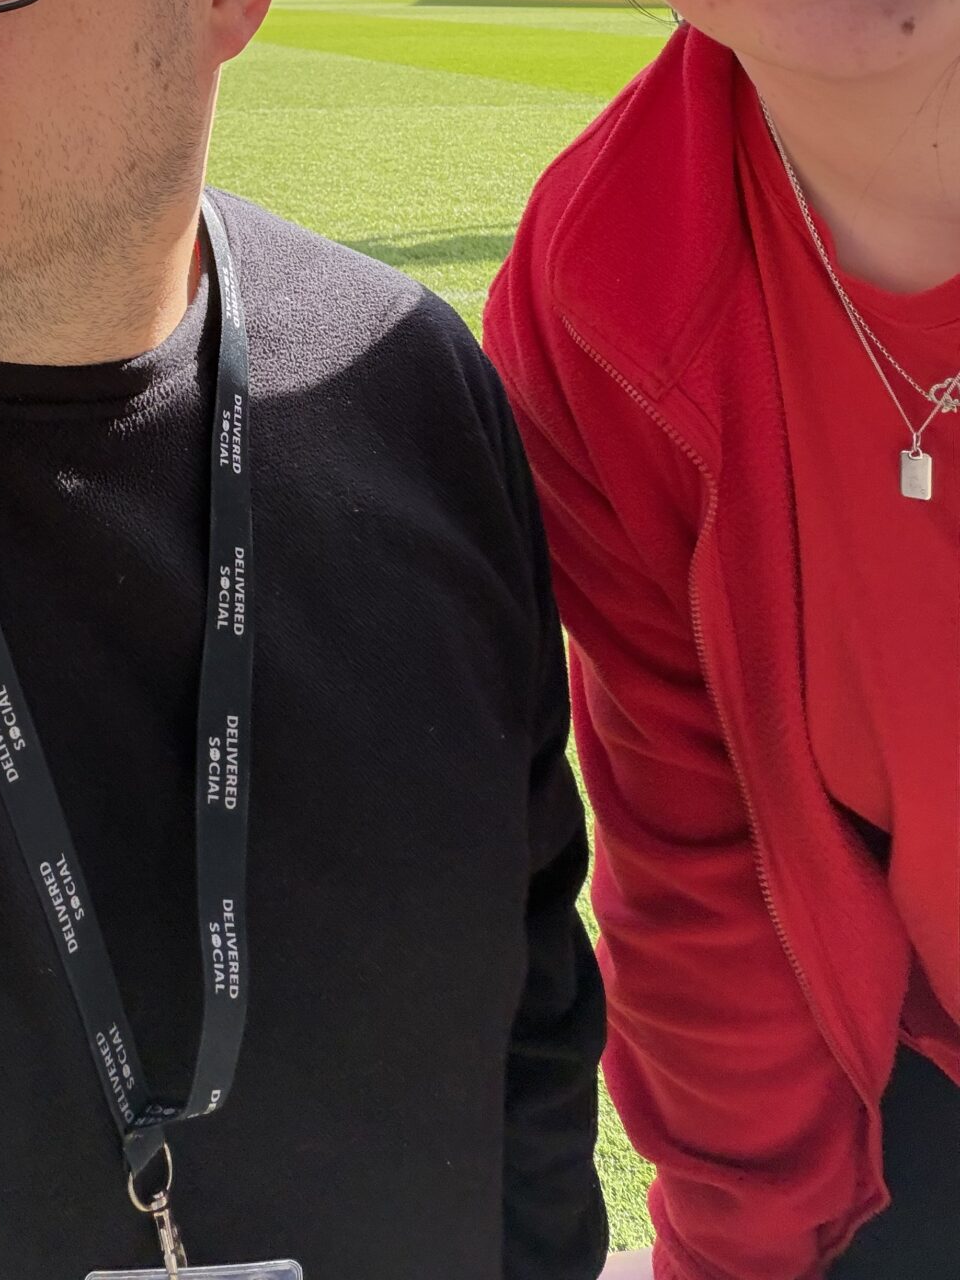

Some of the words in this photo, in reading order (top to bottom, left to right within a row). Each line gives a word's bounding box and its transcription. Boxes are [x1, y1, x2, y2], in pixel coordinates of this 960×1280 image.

[219, 409, 231, 467] SOCIAL
[232, 393, 243, 474] DELIVERED
[216, 565, 231, 630] SOCIAL
[233, 546, 245, 636] DELIVERED
[207, 736, 221, 804] SOCIAL
[225, 715, 239, 810] DELIVERED
[39, 861, 79, 954] DELIVERED
[56, 852, 85, 921] SOCIAL
[209, 922, 226, 994] SOCIAL
[222, 899, 240, 999] DELIVERED
[96, 1032, 135, 1124] DELIVERED
[109, 1021, 135, 1090] SOCIAL
